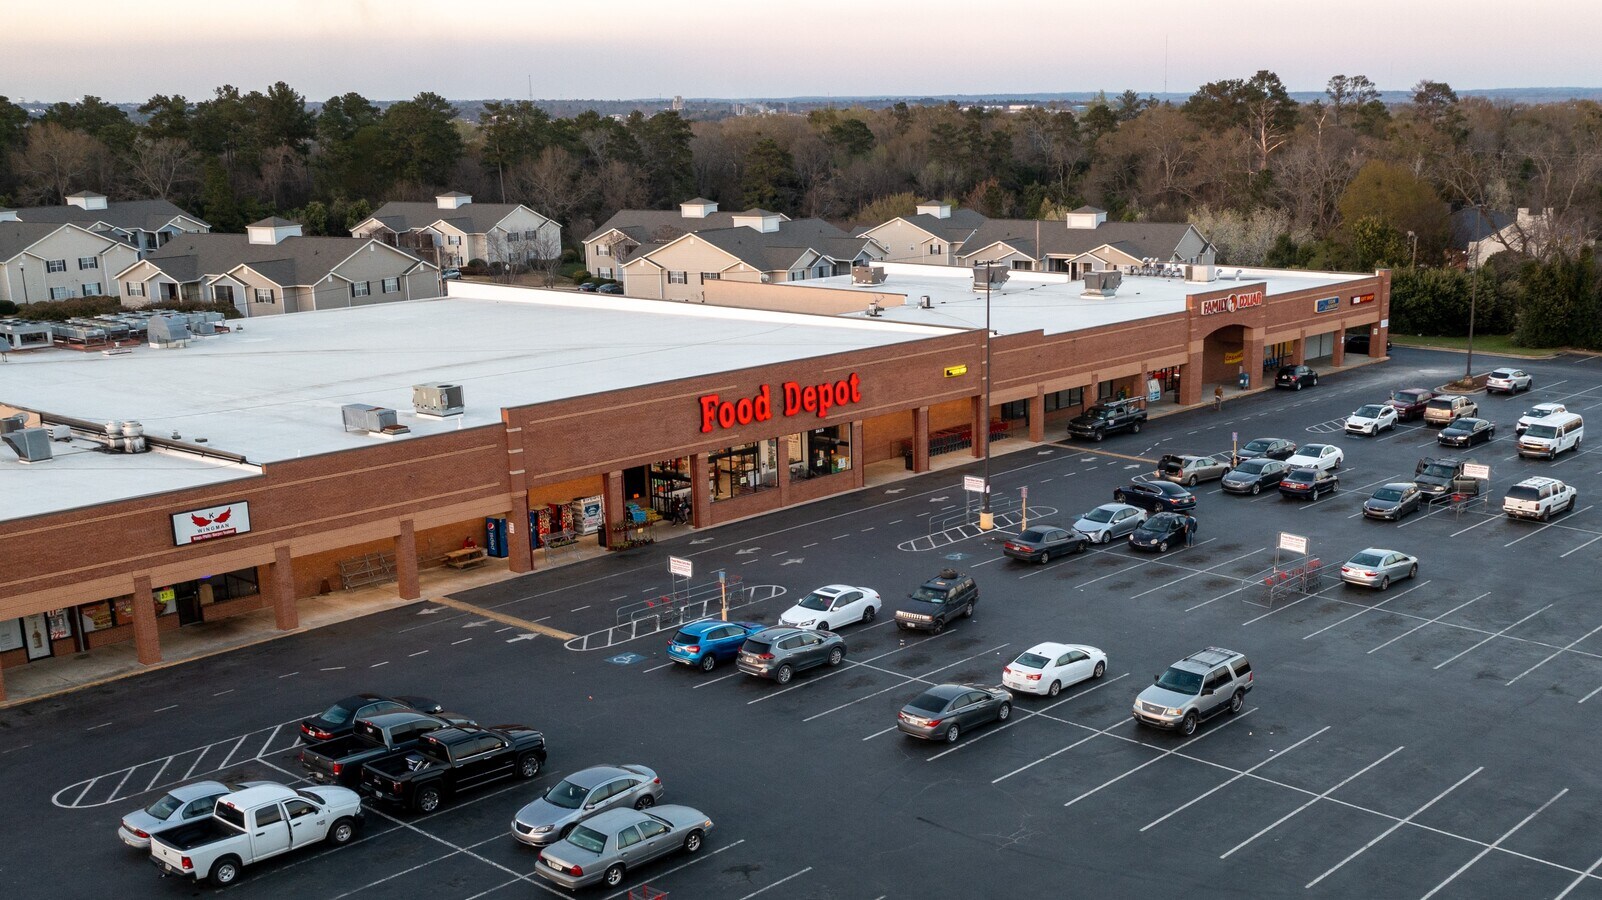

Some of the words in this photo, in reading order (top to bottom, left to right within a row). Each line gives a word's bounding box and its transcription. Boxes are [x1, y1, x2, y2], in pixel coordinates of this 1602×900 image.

[1203, 297, 1228, 315] FAMILY
[699, 384, 773, 433] Food
[782, 372, 862, 418] Depot
[197, 523, 230, 533] WINGMAN
